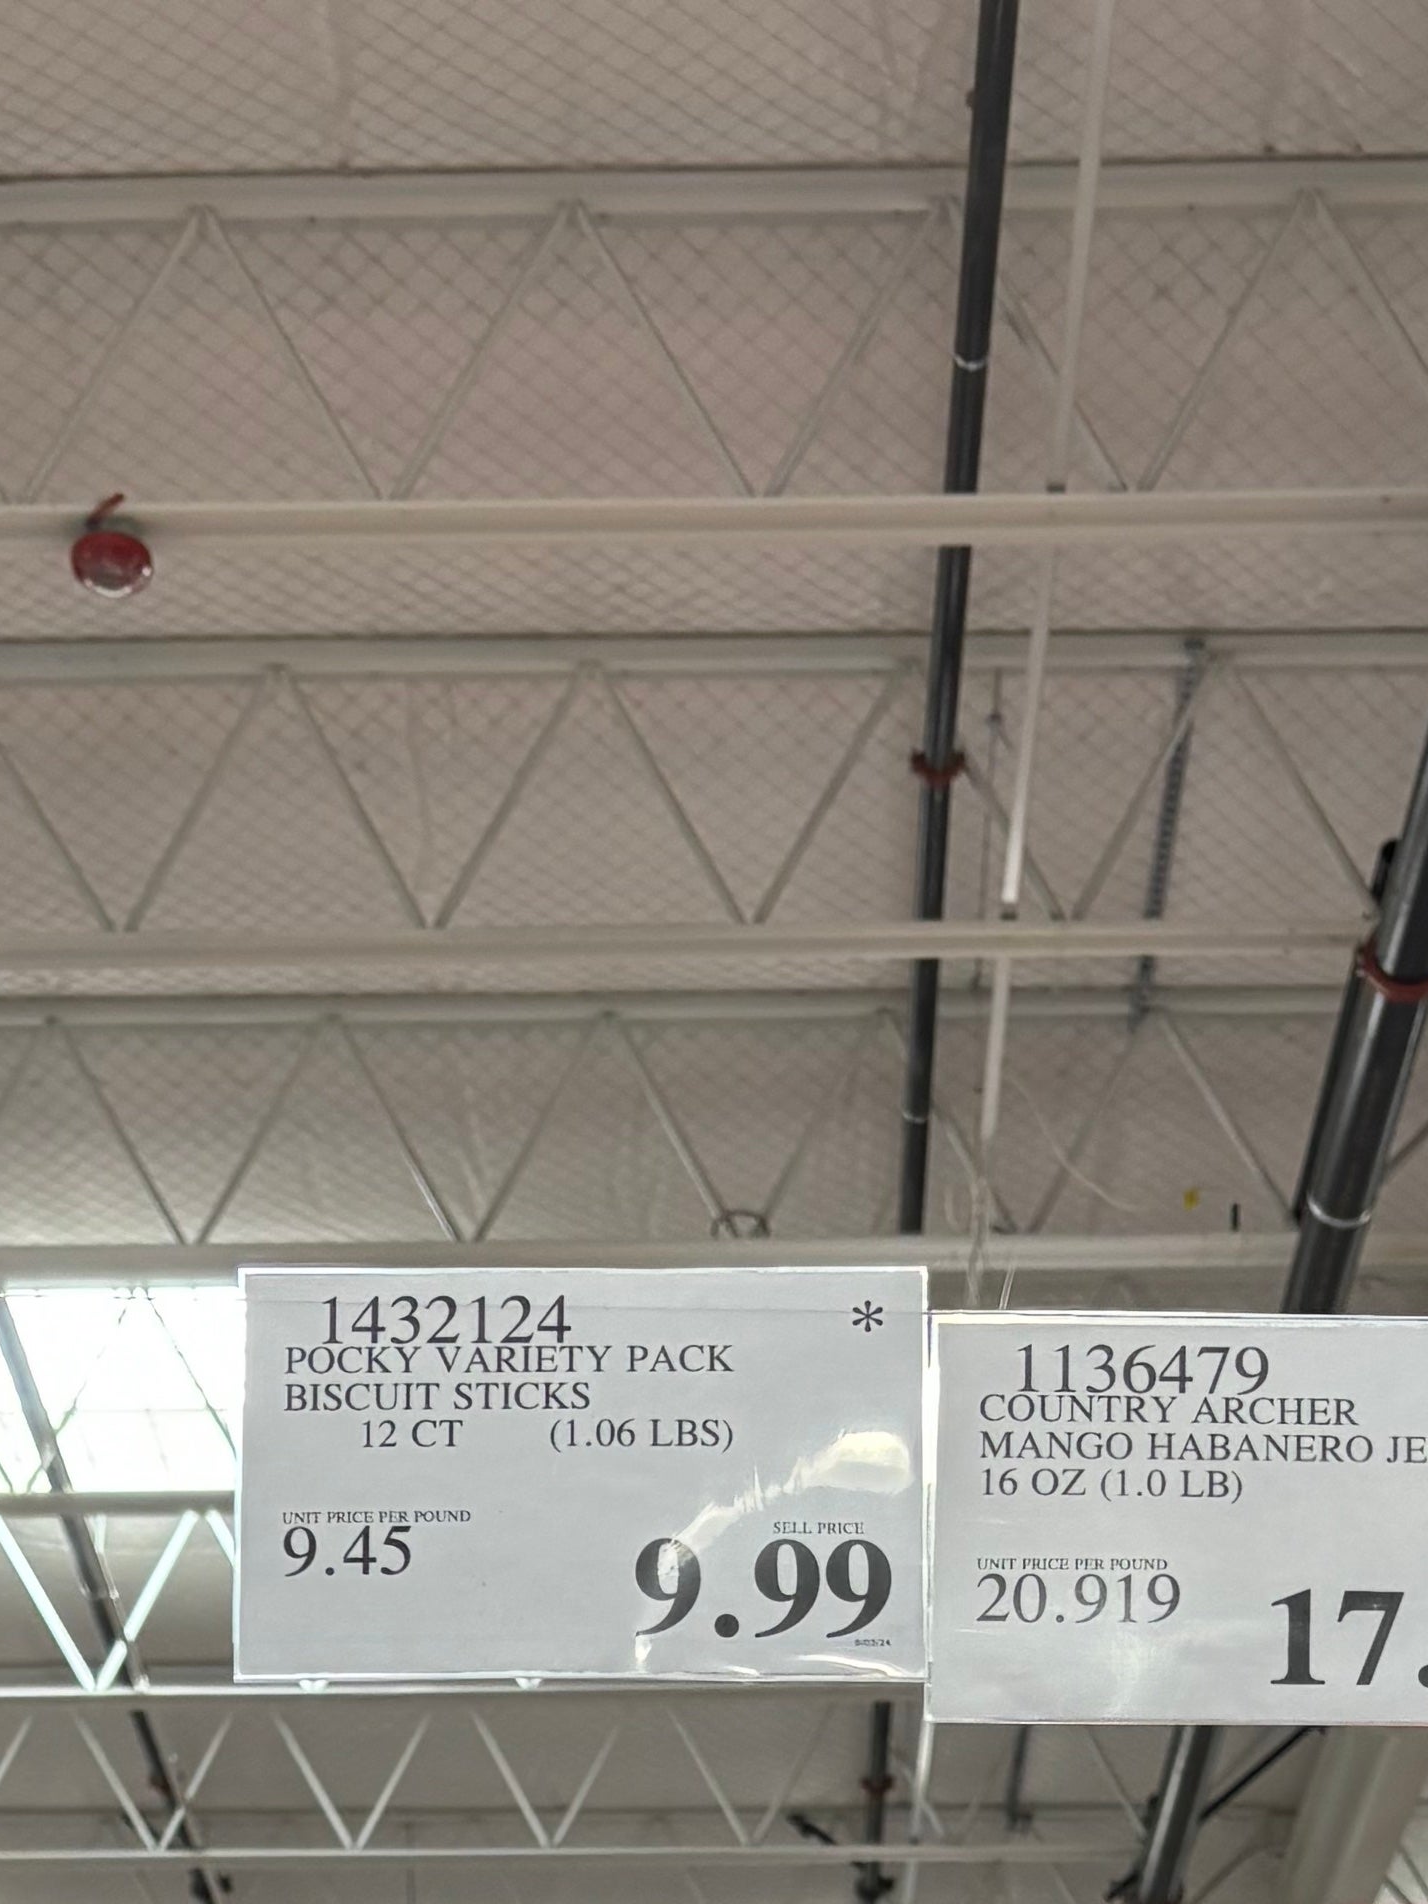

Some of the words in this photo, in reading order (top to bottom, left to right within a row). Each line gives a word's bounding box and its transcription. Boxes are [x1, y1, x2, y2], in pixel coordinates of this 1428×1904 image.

[322, 1295, 572, 1344] 1432124
[284, 1346, 421, 1374] POCKY
[437, 1346, 611, 1374] VARIETY
[627, 1345, 734, 1373] PACK
[1017, 1344, 1270, 1395] 1136479
[284, 1383, 440, 1411] BISCUIT
[453, 1382, 591, 1411] STICKS
[979, 1395, 1175, 1425] COUNTRY
[1192, 1397, 1360, 1427] ARCHER
[362, 1420, 397, 1447] 12
[410, 1420, 464, 1447] CT
[549, 1419, 636, 1453] (1.06
[649, 1418, 734, 1453] LBS)
[979, 1432, 1133, 1461] MANGO
[1148, 1433, 1373, 1463] HABANERO
[981, 1469, 1019, 1496] 16
[1030, 1469, 1086, 1497] OZ
[1100, 1469, 1167, 1501] (1.0
[1180, 1470, 1243, 1502] LB)
[282, 1526, 413, 1577] 9.45
[977, 1558, 1016, 1571] UNIT
[1022, 1558, 1069, 1571] PRICE
[1074, 1558, 1105, 1571] PER
[1110, 1558, 1167, 1571] POUND
[635, 1538, 893, 1639] 9.99
[975, 1573, 1181, 1624] 20.919
